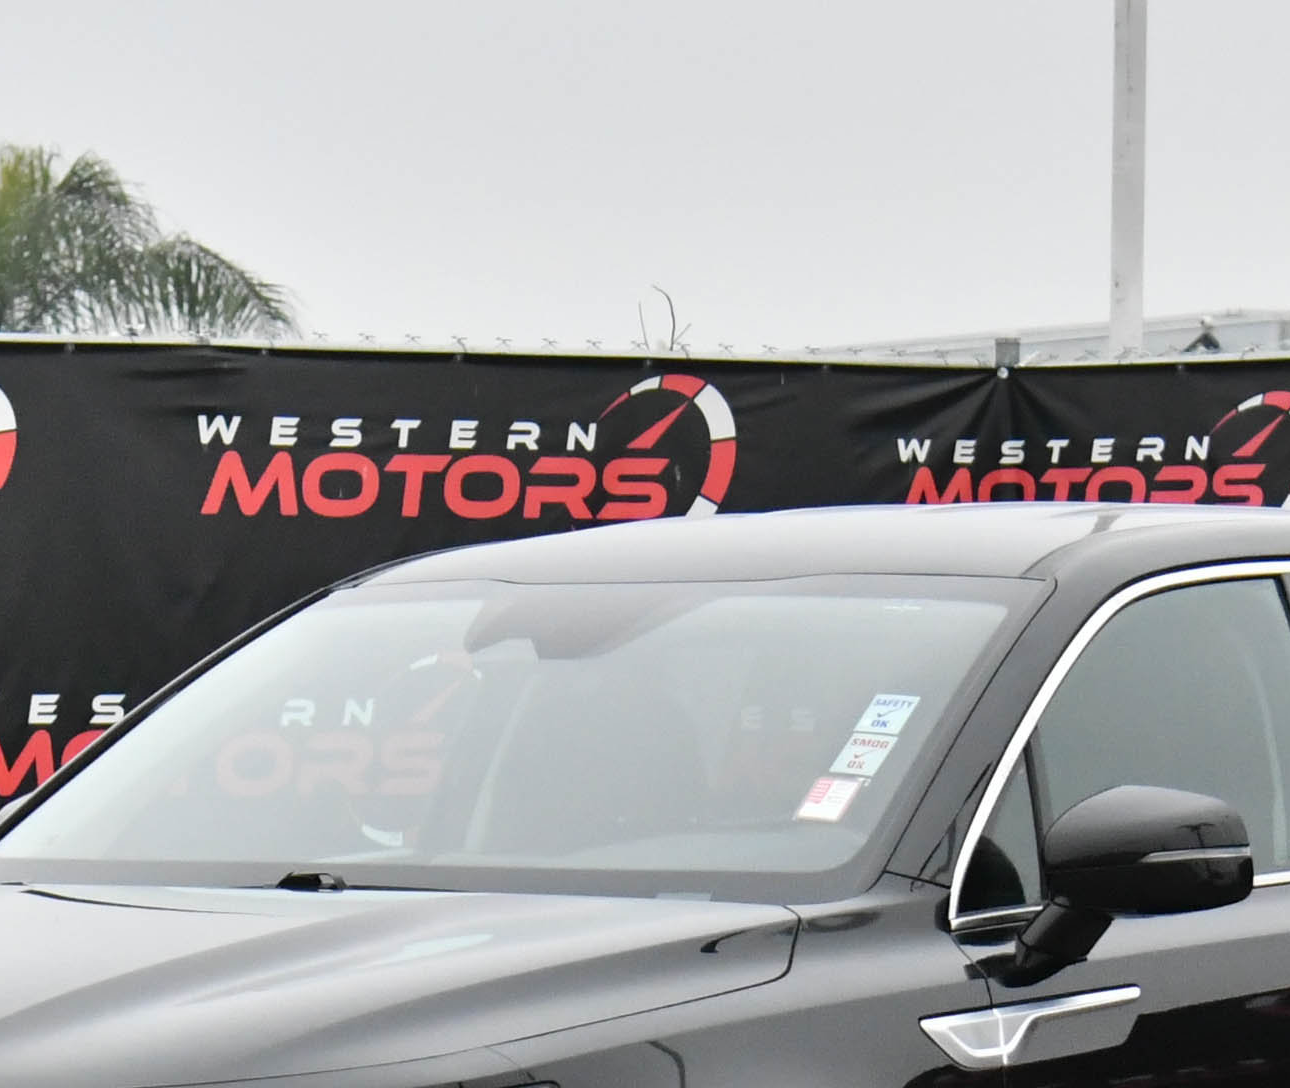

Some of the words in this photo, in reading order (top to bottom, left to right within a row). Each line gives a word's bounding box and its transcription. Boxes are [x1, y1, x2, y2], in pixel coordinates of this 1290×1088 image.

[197, 414, 597, 452] WESTERN
[897, 435, 1210, 465] WESTERN
[200, 449, 670, 521] MOTORS
[905, 463, 1266, 508] MOTORS
[873, 697, 916, 709] SAFETY
[870, 719, 890, 729] OK
[851, 737, 890, 749] SMOG
[847, 759, 865, 770] OK
